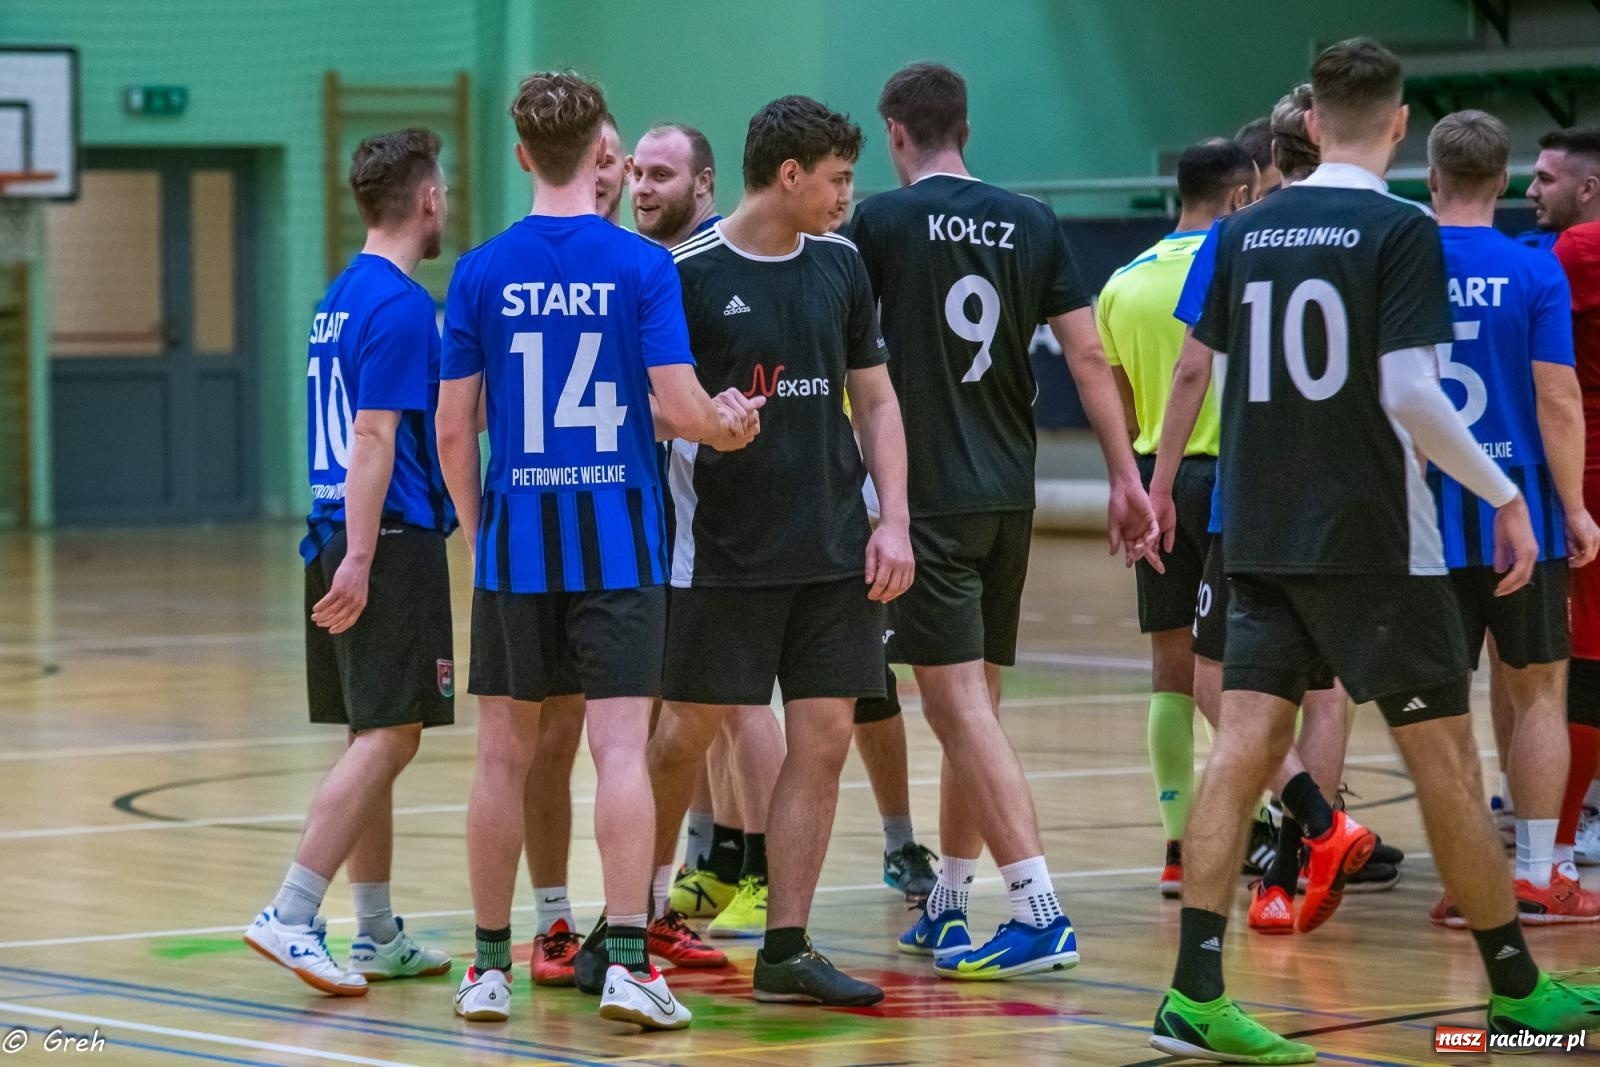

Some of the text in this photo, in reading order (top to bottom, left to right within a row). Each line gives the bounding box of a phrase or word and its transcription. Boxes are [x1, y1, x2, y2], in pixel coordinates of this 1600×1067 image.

[927, 213, 1016, 250] KOŁCZ
[1241, 226, 1361, 252] FLEGERINHO
[500, 282, 616, 318] START
[1447, 276, 1510, 308] ART
[723, 305, 751, 316] adidas
[944, 274, 1001, 383] 9
[1241, 277, 1350, 402] 10
[508, 331, 628, 454] 14
[743, 362, 830, 398] Nexans
[307, 356, 355, 471] 10
[1480, 441, 1513, 459] ELKIE
[511, 464, 626, 487] PIETROWICE WIELKIE
